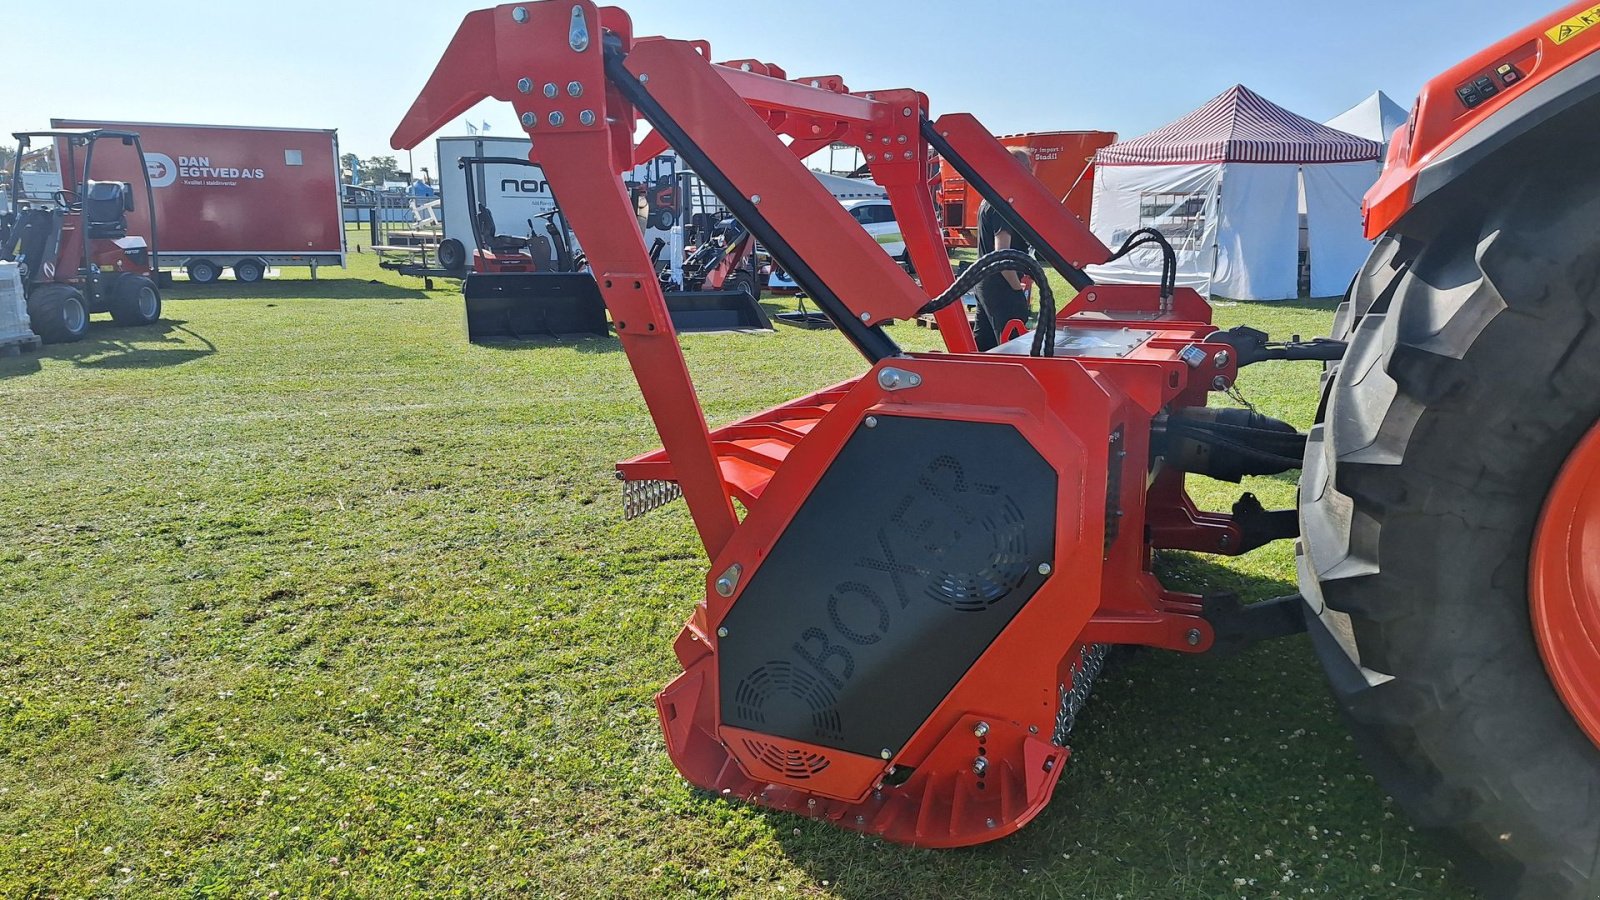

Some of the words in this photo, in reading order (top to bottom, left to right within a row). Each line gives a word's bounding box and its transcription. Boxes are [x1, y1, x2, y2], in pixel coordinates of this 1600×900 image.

[178, 156, 210, 167] DAN
[180, 167, 239, 178] EGTVED
[241, 168, 265, 179] A/S
[792, 455, 1001, 691] BOXER
